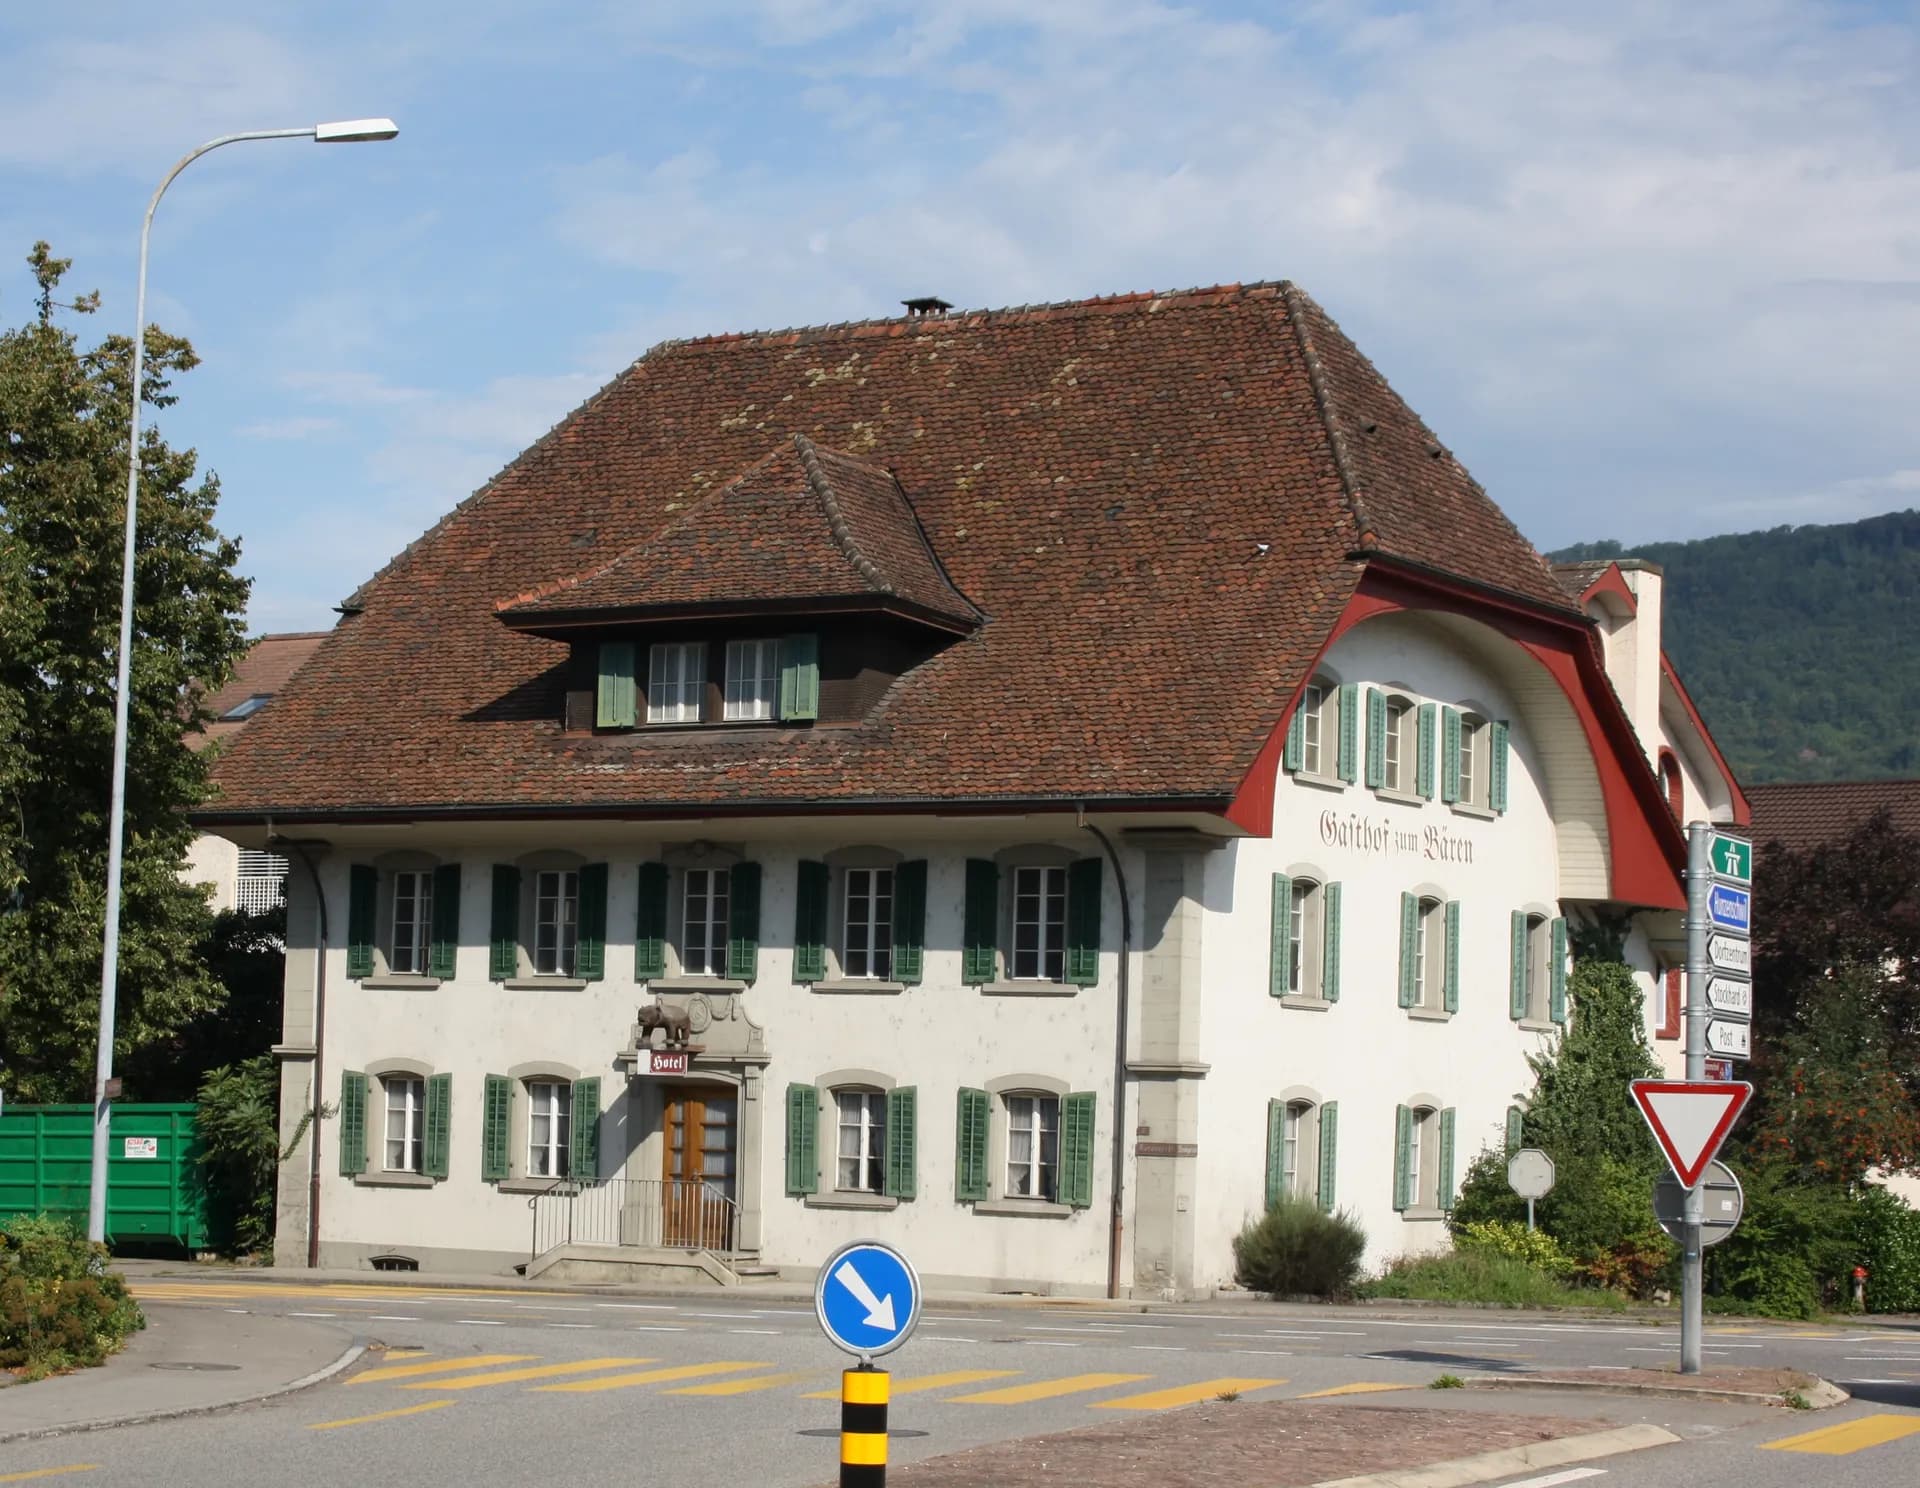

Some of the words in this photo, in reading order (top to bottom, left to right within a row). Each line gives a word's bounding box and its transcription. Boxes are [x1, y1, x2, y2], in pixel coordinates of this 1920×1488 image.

[1395, 830, 1418, 857] zum
[1424, 824, 1473, 864] Bären
[1714, 940, 1748, 965] Dorfzentrum
[1720, 1026, 1733, 1047] Post
[653, 1055, 683, 1070] Hotel
